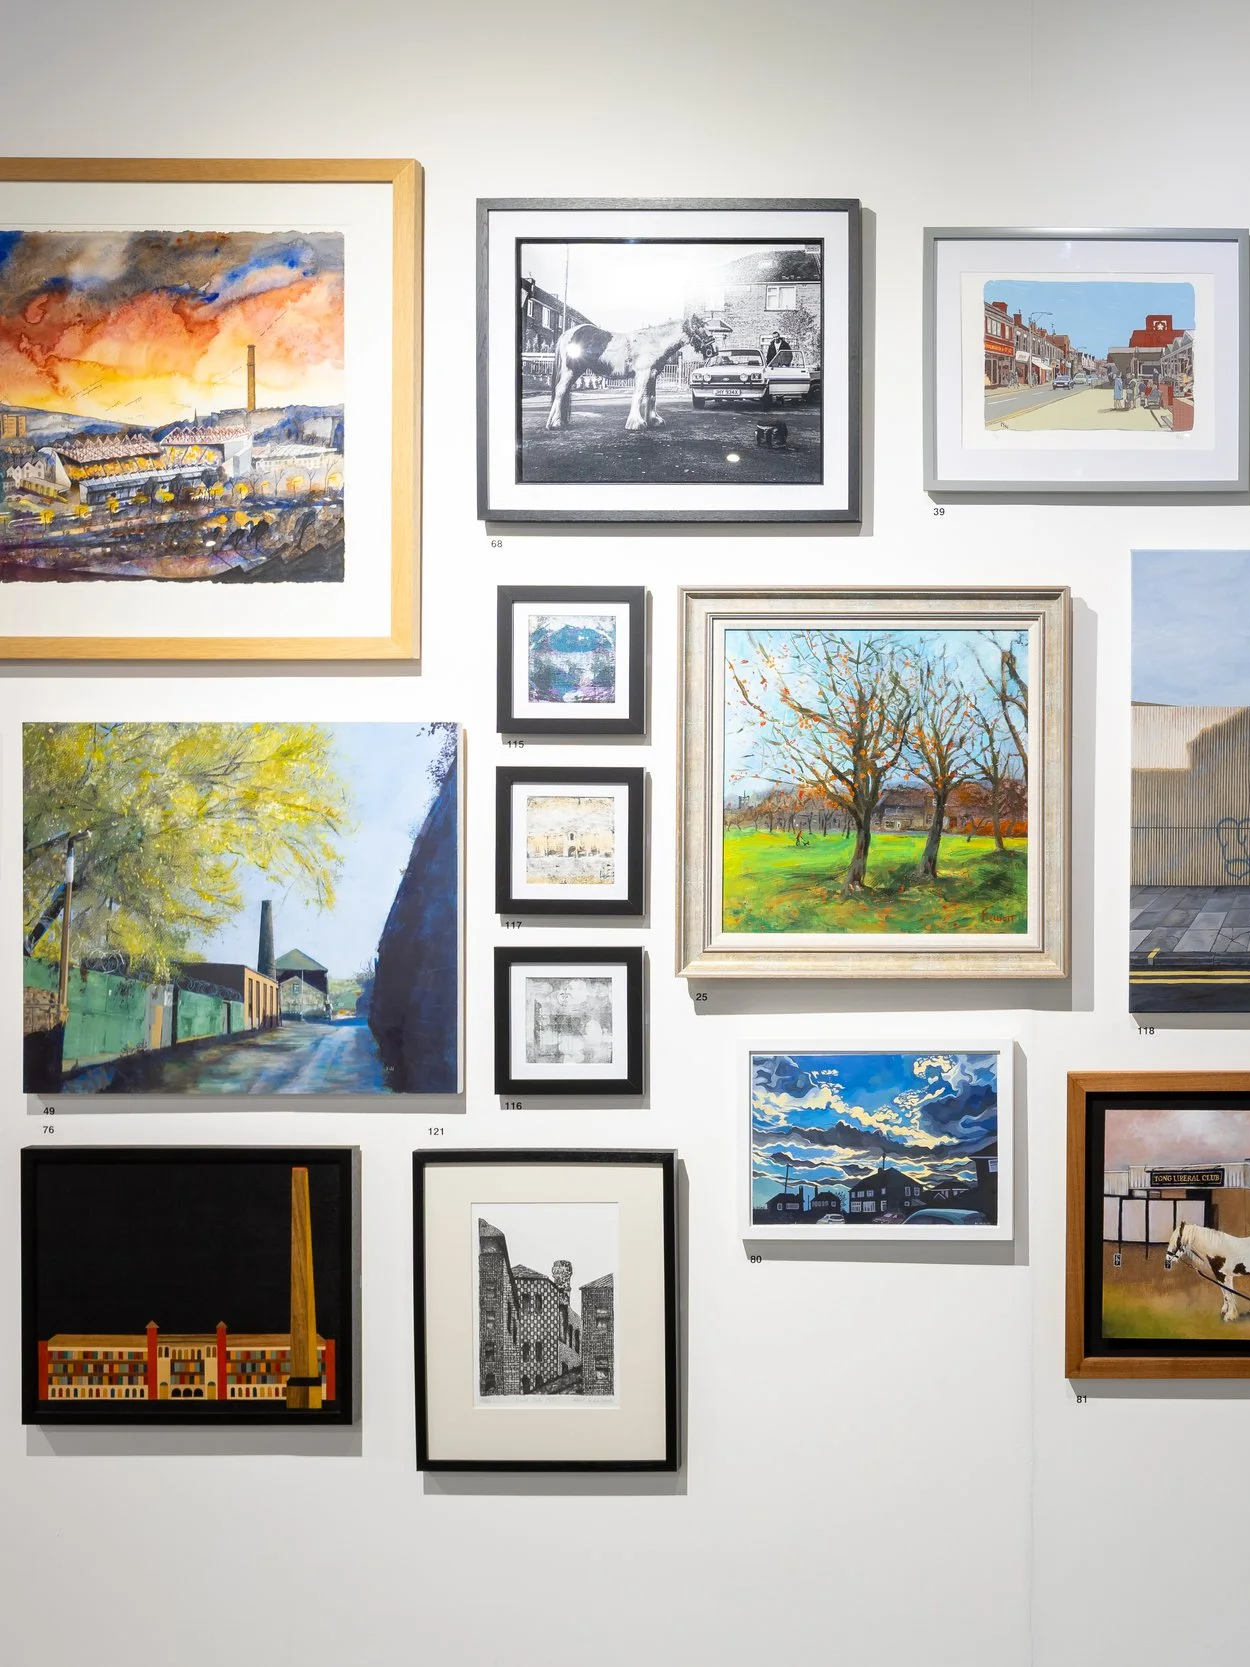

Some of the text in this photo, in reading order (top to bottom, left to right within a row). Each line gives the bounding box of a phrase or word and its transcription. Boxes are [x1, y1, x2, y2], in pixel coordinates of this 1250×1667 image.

[933, 507, 946, 516] 39
[490, 539, 503, 548] 68
[507, 739, 525, 749] 115
[505, 921, 523, 930] 117
[695, 992, 708, 1002] 25
[1137, 1026, 1155, 1035] 118
[504, 1102, 523, 1111] 116
[43, 1107, 56, 1116] 49
[42, 1125, 55, 1134] 76
[427, 1127, 444, 1136] 121
[1154, 1174, 1220, 1182] TONG LIBERAL CLUB
[750, 1255, 762, 1264] 80
[1076, 1395, 1088, 1404] 81
